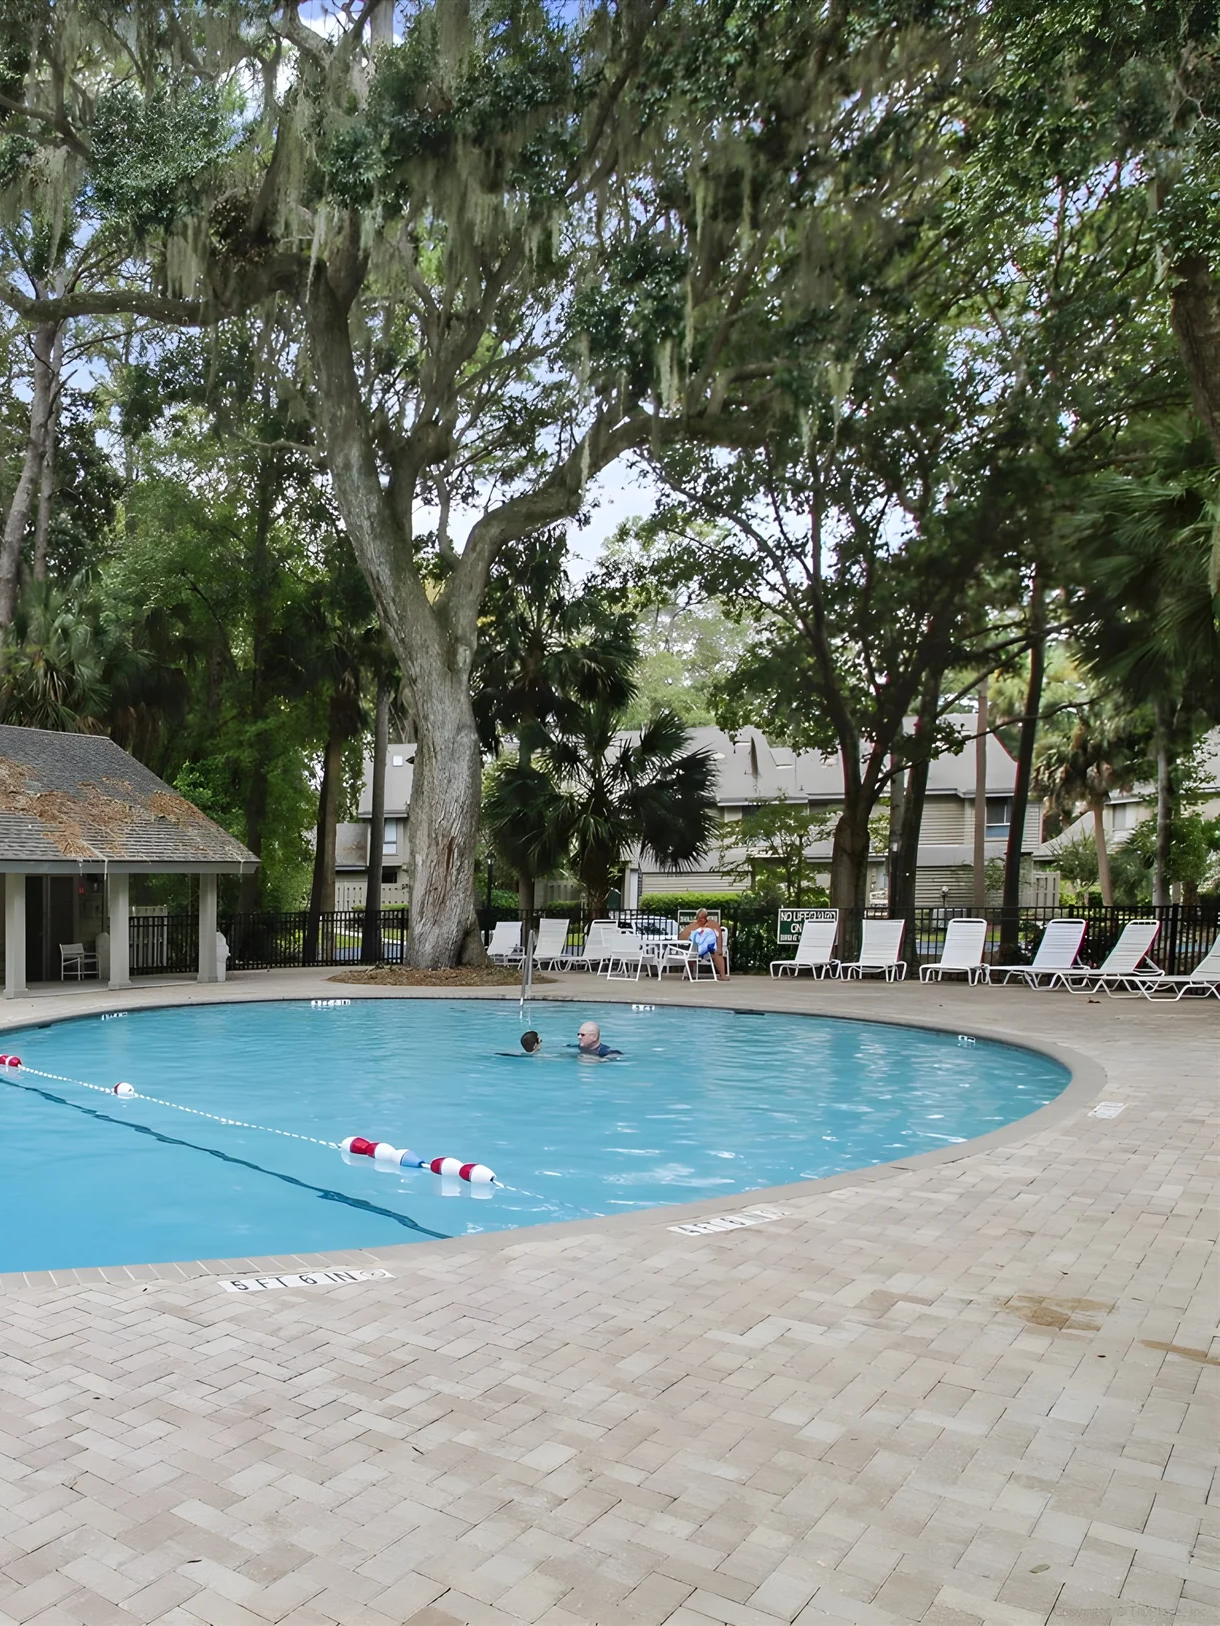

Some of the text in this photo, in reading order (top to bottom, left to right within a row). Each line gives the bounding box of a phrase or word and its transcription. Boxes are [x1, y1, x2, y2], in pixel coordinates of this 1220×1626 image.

[780, 911, 792, 922] NO
[230, 1271, 359, 1291] 5 FT 6 IN
